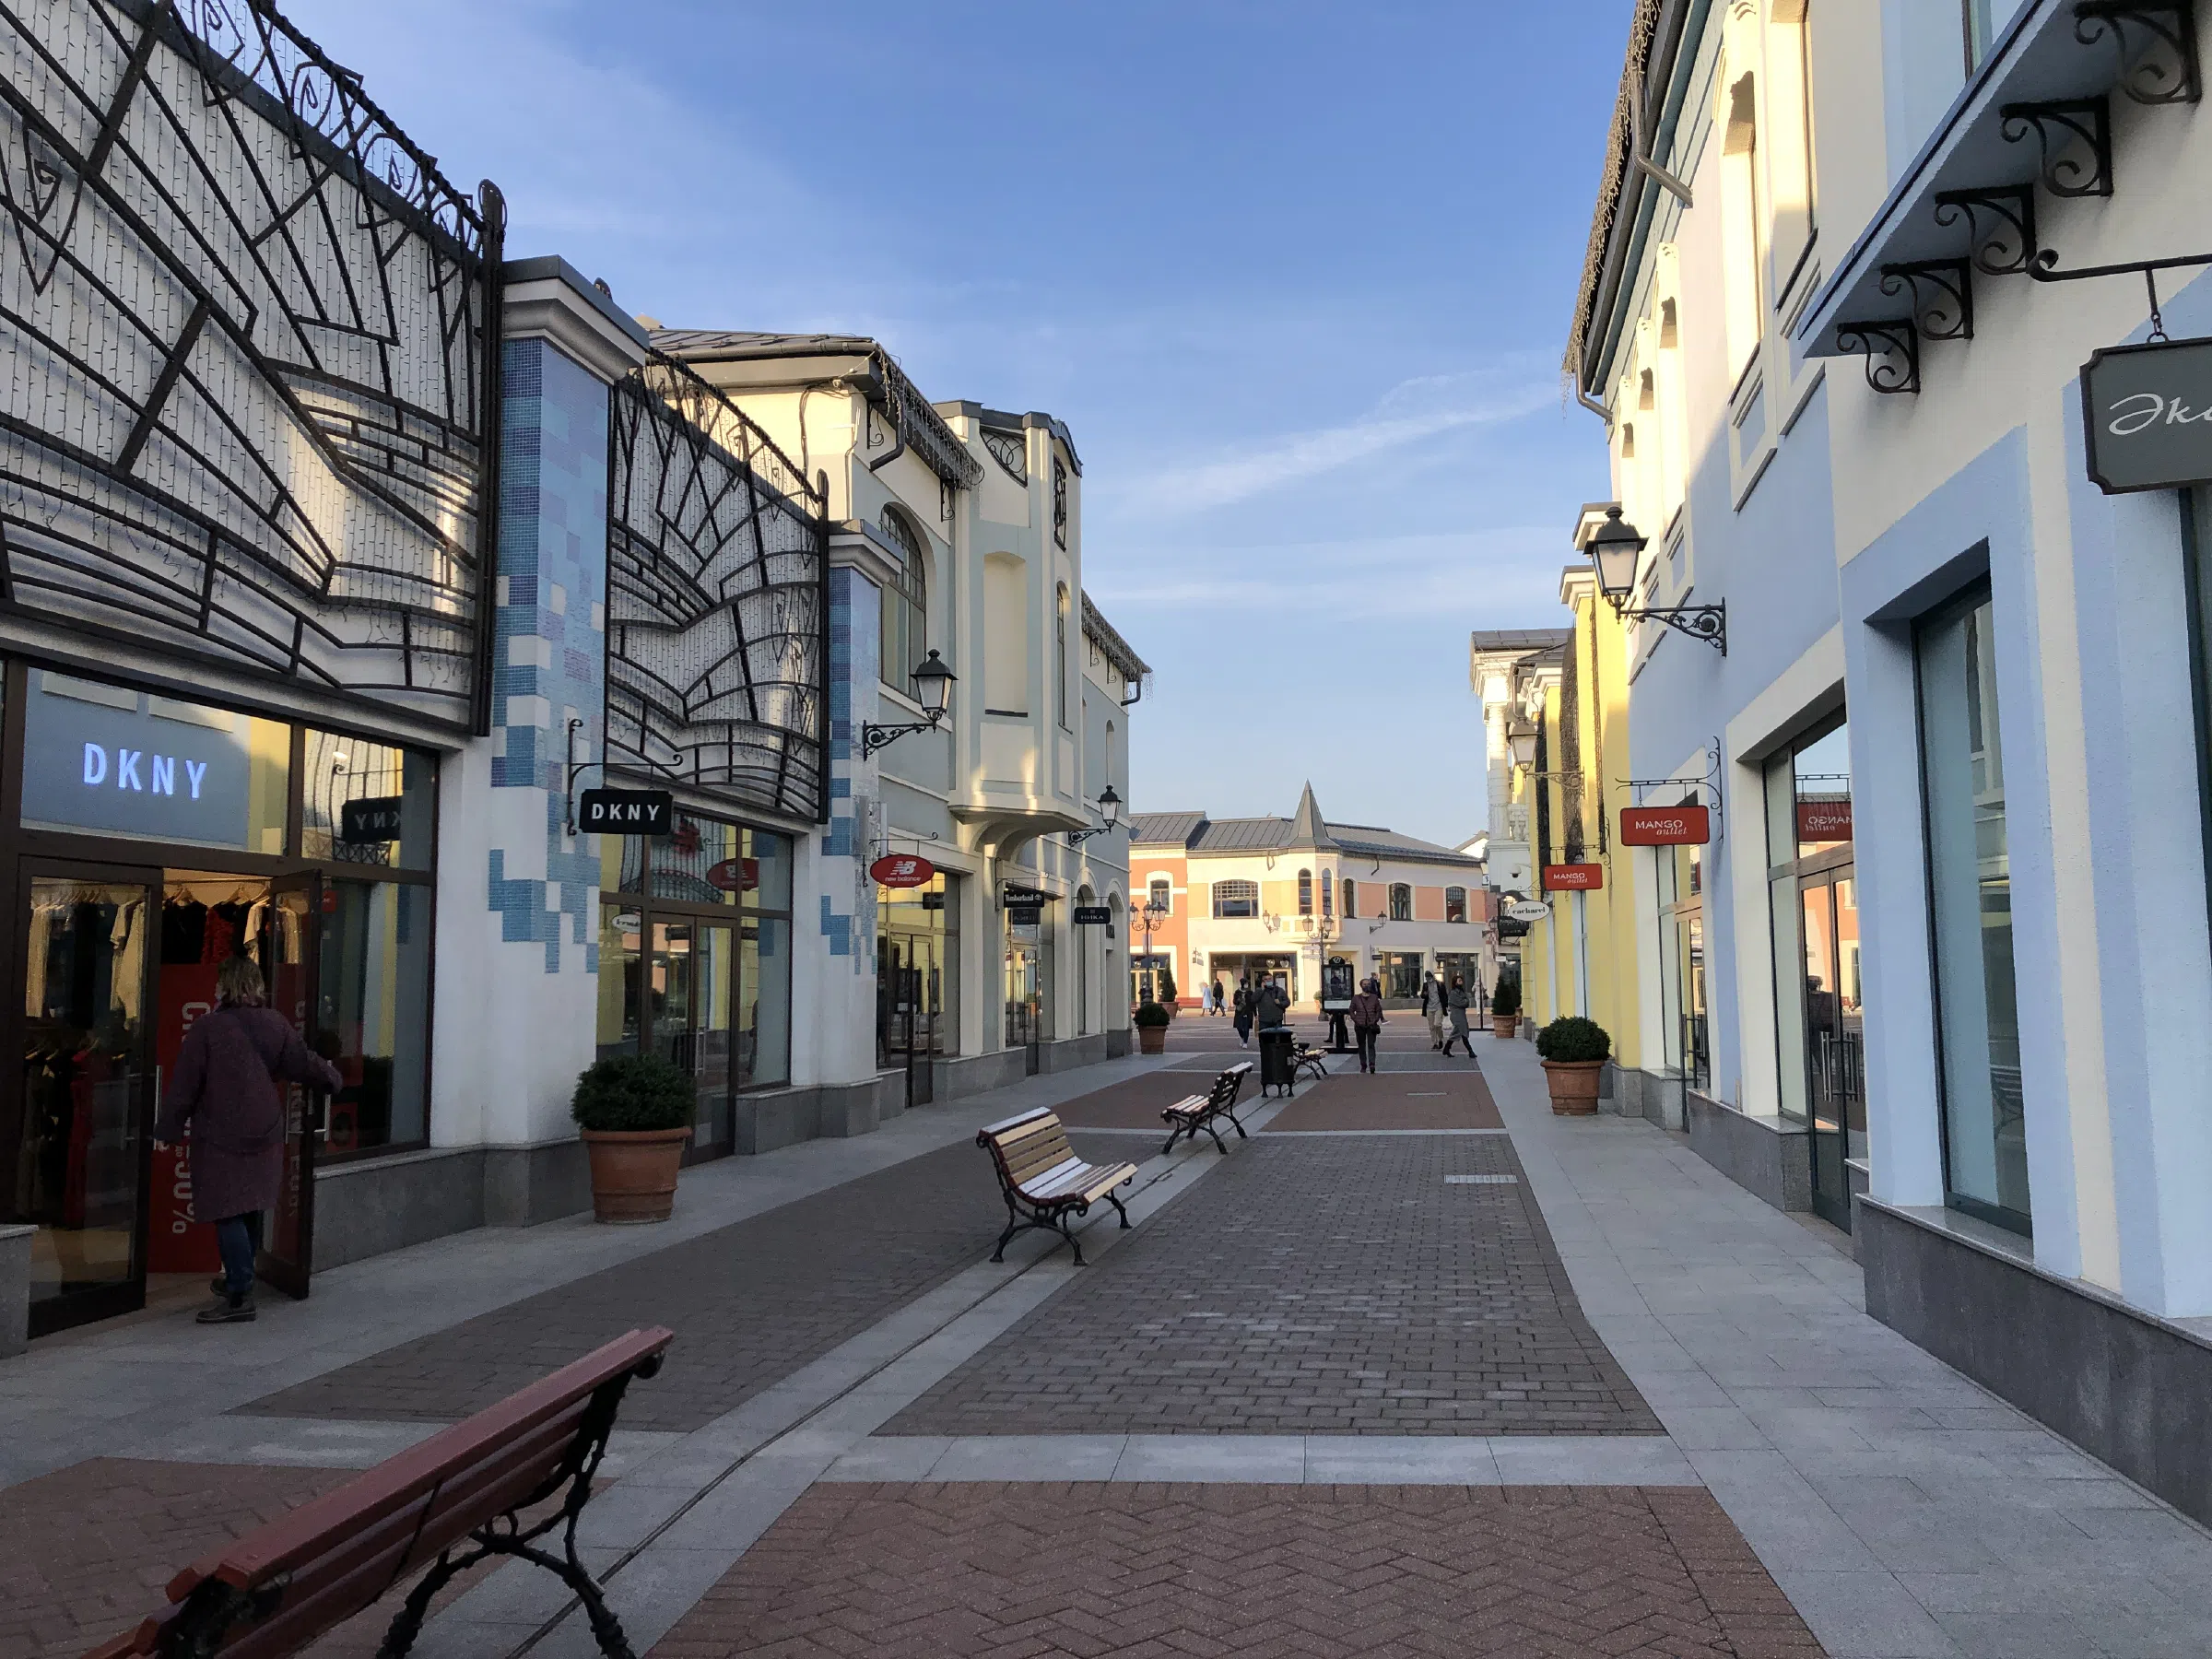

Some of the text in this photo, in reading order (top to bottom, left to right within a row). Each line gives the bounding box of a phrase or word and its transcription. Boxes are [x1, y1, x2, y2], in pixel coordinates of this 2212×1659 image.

[84, 742, 207, 799] DKNY
[591, 803, 660, 821] DKNY
[1635, 819, 1683, 830] MANGO
[1656, 827, 1688, 836] outlet
